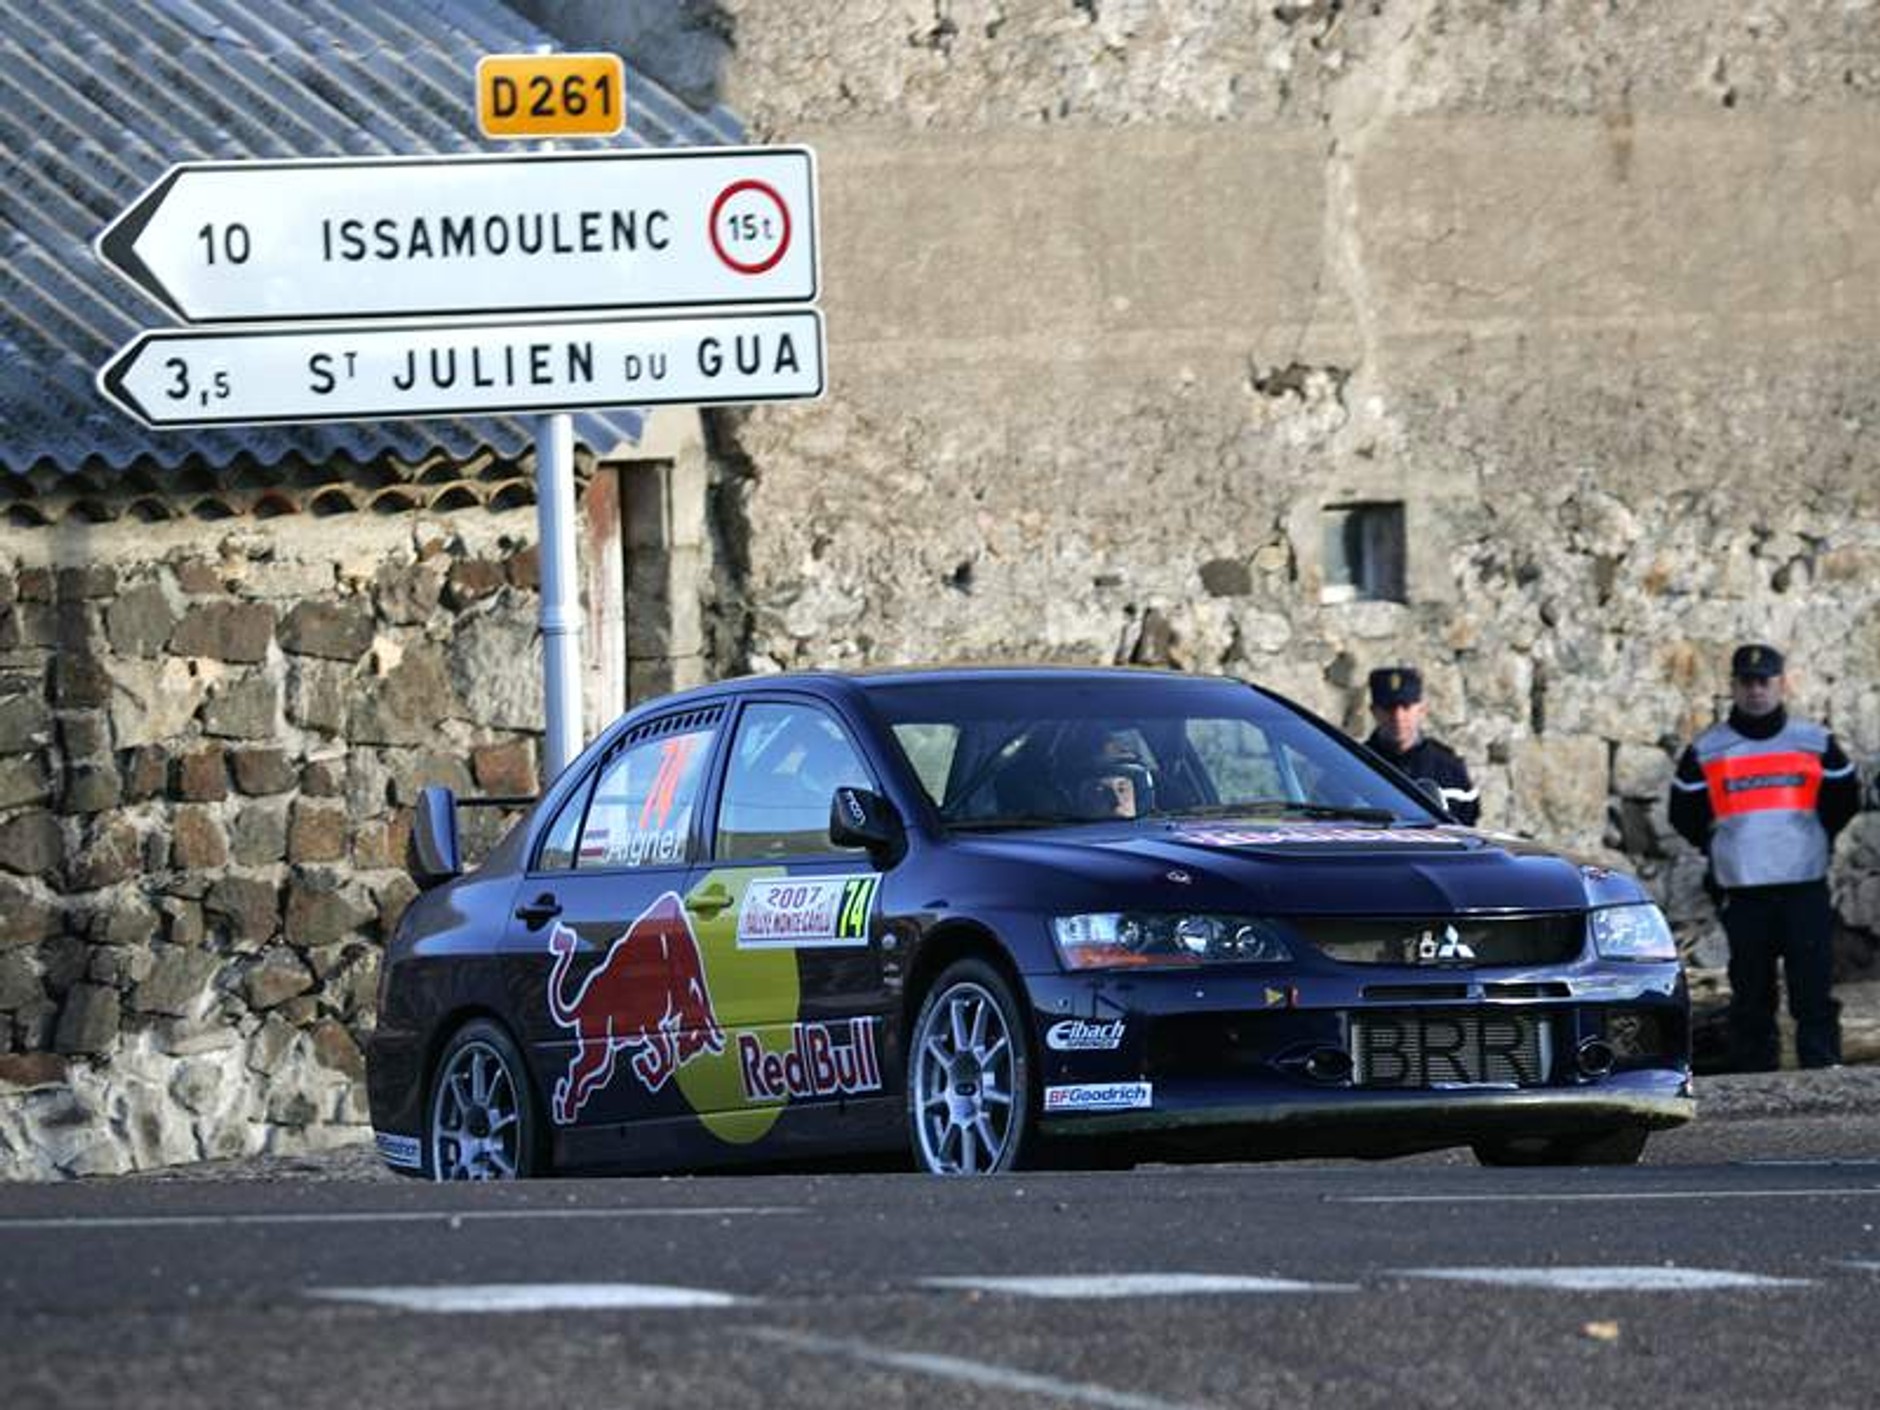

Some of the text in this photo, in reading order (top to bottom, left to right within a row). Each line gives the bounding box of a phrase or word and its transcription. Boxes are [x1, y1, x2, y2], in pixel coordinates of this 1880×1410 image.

[198, 210, 670, 265] 10 ISSAMOULENC
[165, 357, 231, 407] 3,5
[392, 342, 594, 391] JULIEN
[625, 354, 667, 382] DU
[697, 333, 800, 378] GUA
[768, 885, 823, 909] 2007
[839, 879, 873, 938] 74
[1046, 1019, 1126, 1049] Eibach
[1358, 1015, 1539, 1086] BRR
[1049, 1086, 1147, 1103] BFGoodrich
